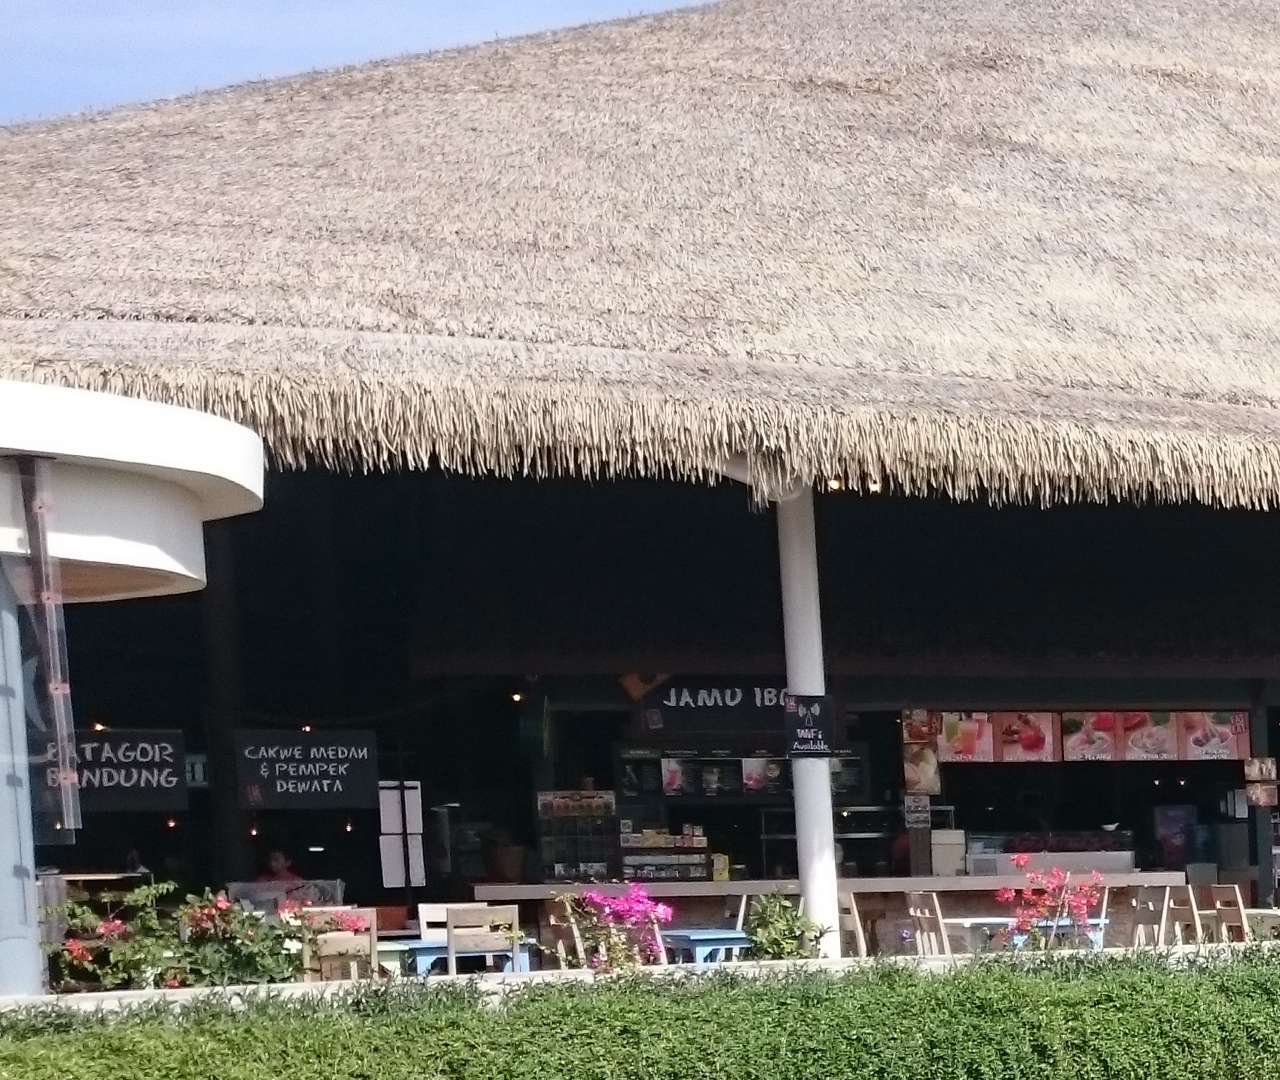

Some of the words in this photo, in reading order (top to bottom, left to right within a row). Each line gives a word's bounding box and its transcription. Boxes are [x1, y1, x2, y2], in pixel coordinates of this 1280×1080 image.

[663, 687, 742, 707] JAMU
[244, 746, 303, 760] CAKWE
[309, 746, 369, 760] MEDAN
[275, 762, 350, 776] PEMPEK
[46, 767, 179, 788] BNDUNG
[275, 779, 344, 793] DEWATA
